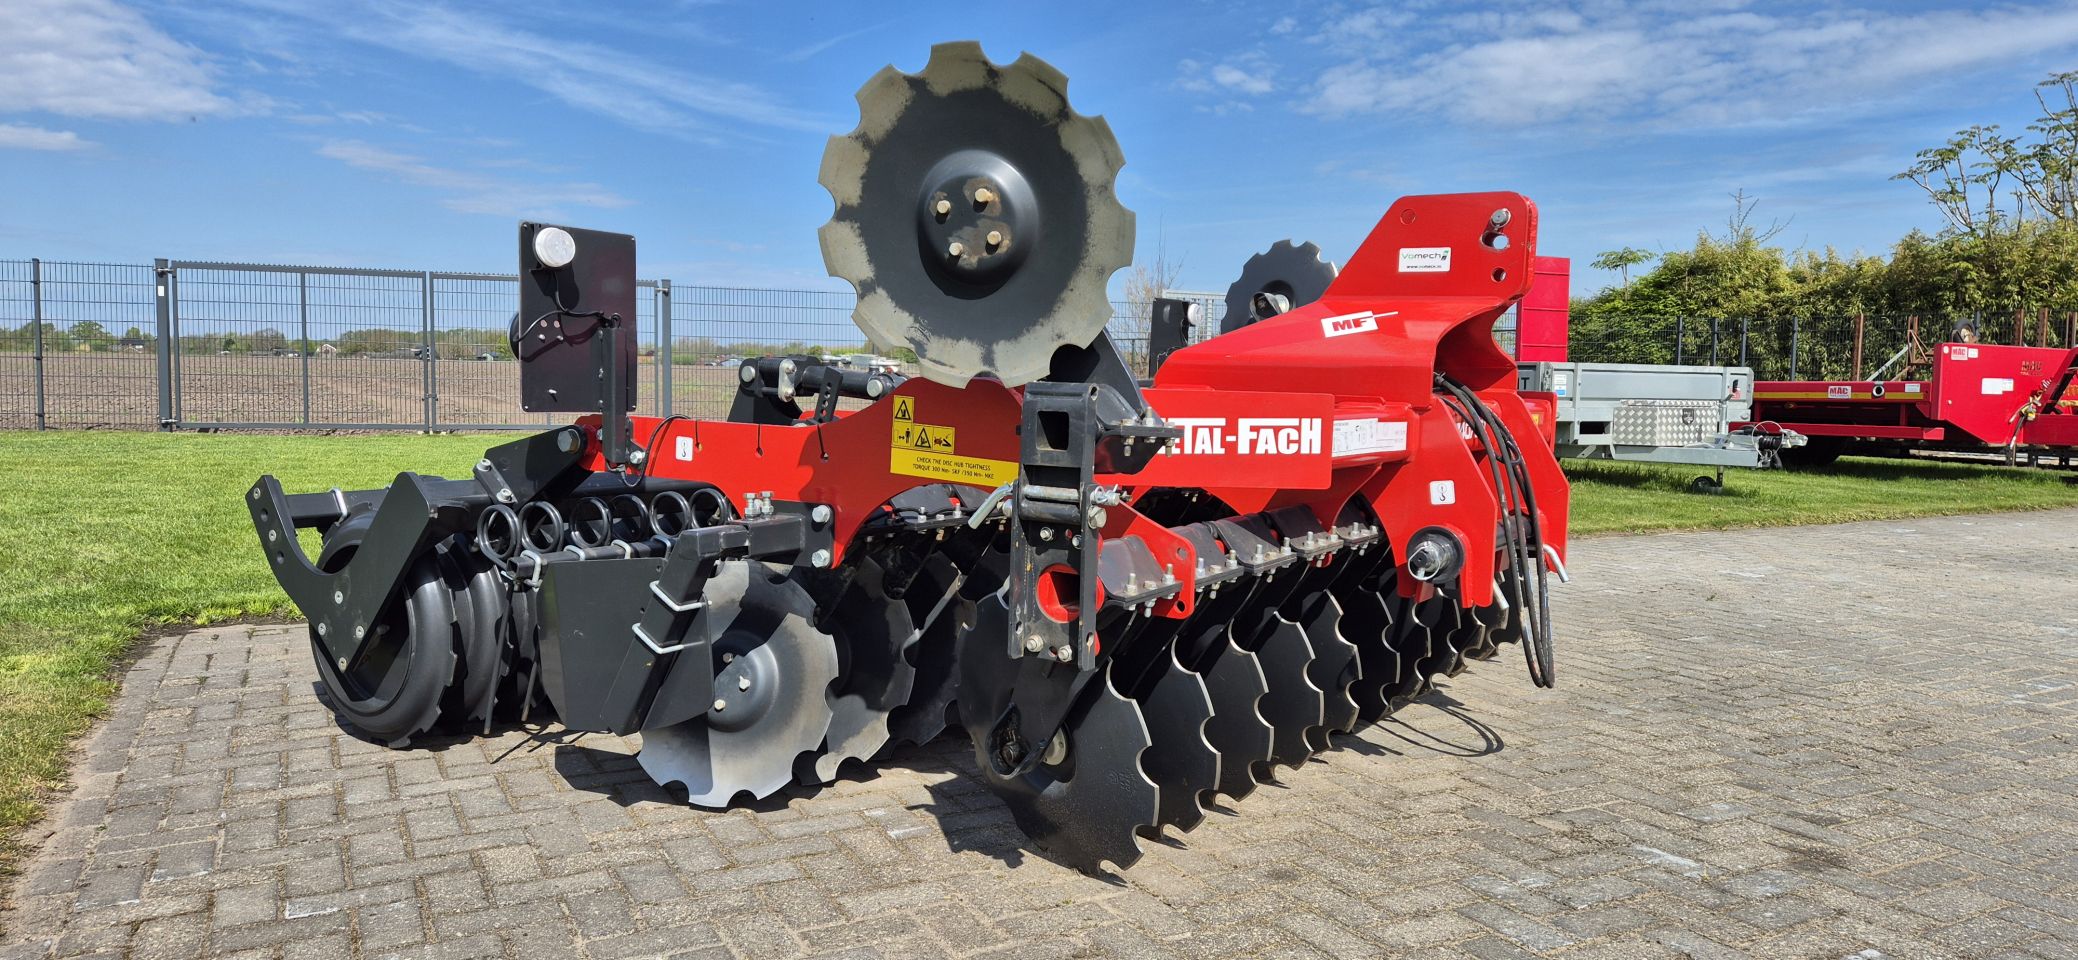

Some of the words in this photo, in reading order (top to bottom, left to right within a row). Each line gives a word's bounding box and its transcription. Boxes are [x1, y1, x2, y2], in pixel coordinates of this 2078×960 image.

[1332, 317, 1372, 331] MF
[1829, 387, 1848, 395] MAC
[1157, 418, 1322, 454] ETAL-FACH
[913, 463, 931, 471] TORQUE
[916, 456, 931, 464] CHECK
[965, 462, 991, 471] TIGHTNESS
